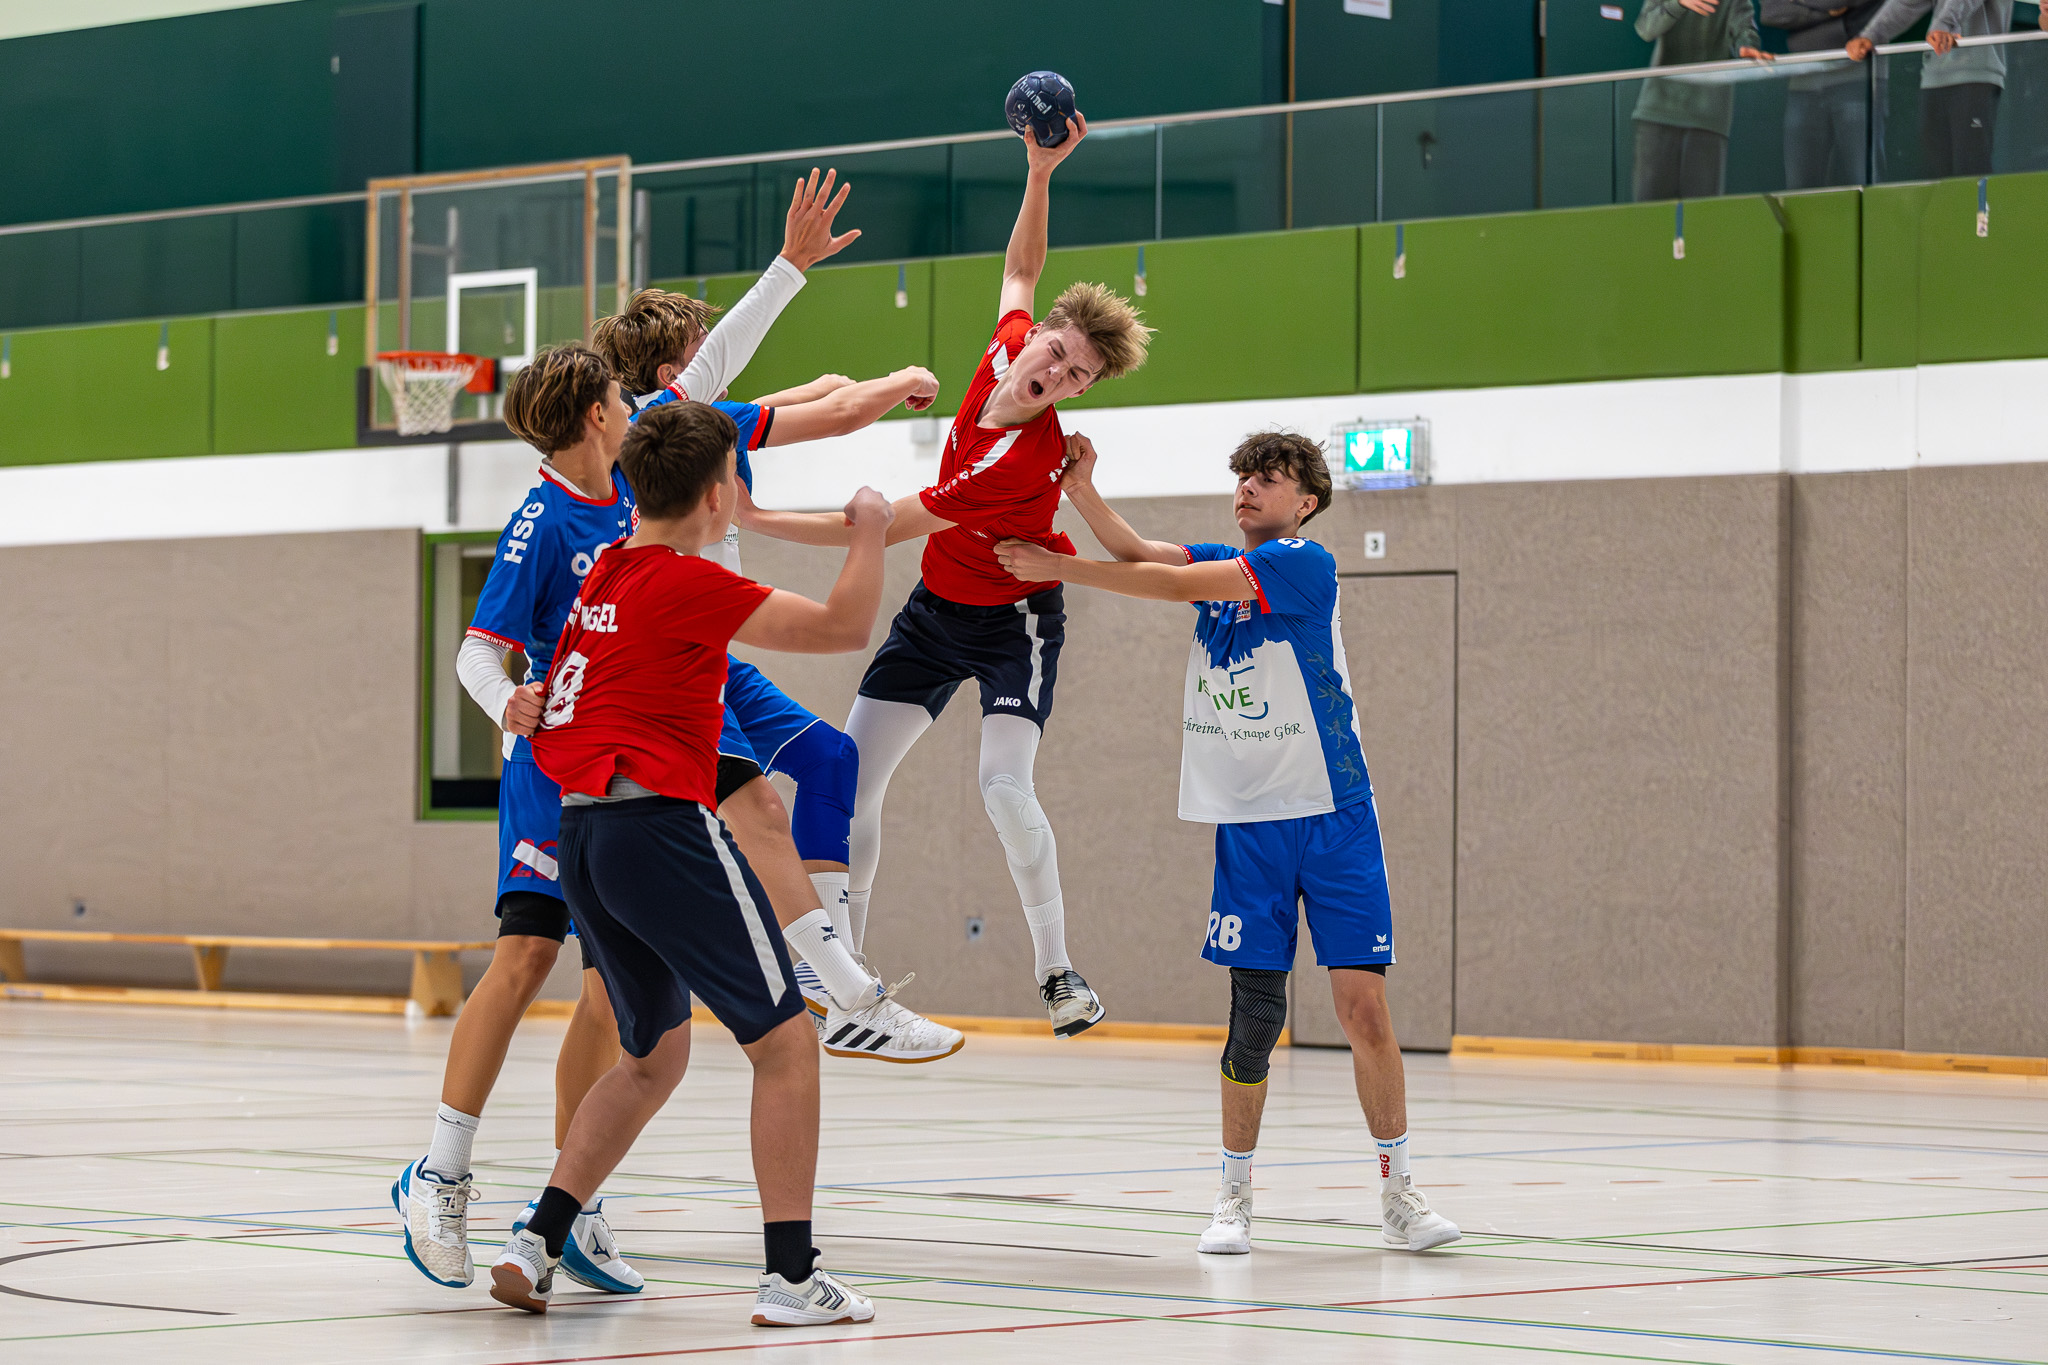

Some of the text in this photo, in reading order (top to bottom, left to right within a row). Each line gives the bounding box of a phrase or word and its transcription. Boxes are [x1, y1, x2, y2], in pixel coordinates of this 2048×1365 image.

[503, 501, 545, 565] HSG
[993, 696, 1022, 707] JAKO
[1231, 728, 1270, 742] Knape
[1274, 722, 1305, 741] GbR
[1372, 944, 1390, 952] erima
[1379, 1153, 1391, 1178] HSG
